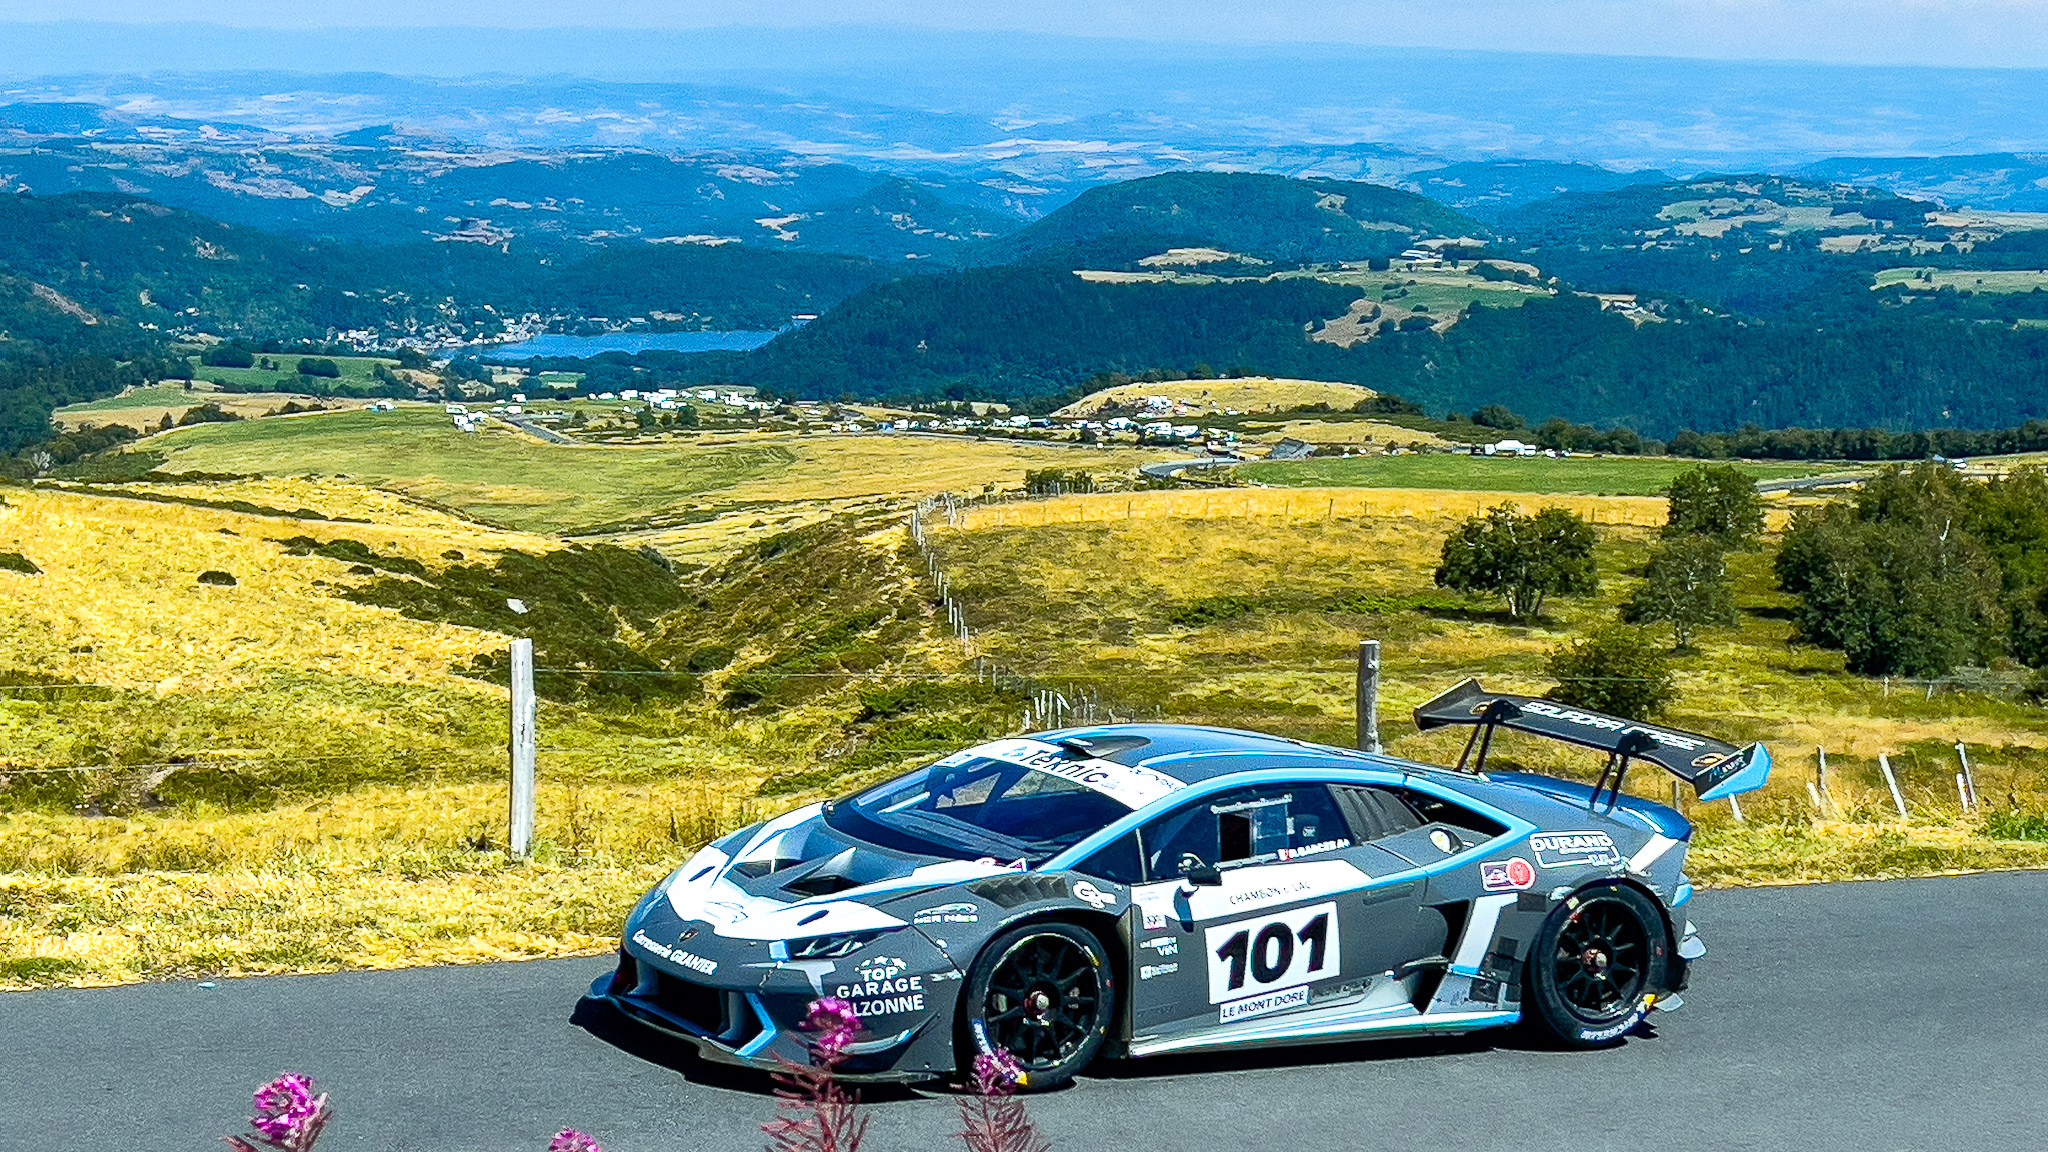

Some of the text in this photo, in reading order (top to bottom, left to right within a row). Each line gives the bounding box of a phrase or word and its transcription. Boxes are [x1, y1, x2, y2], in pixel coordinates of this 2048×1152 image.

[1519, 701, 1627, 732] SQUADRA
[1530, 835, 1614, 852] DURAND
[1229, 886, 1281, 905] CHAMBON
[1216, 912, 1329, 991] 101
[860, 966, 899, 982] TOP
[836, 976, 923, 999] GARAGE
[852, 994, 925, 1017] LZONNE
[1222, 990, 1305, 1018] LE MONT DORE
